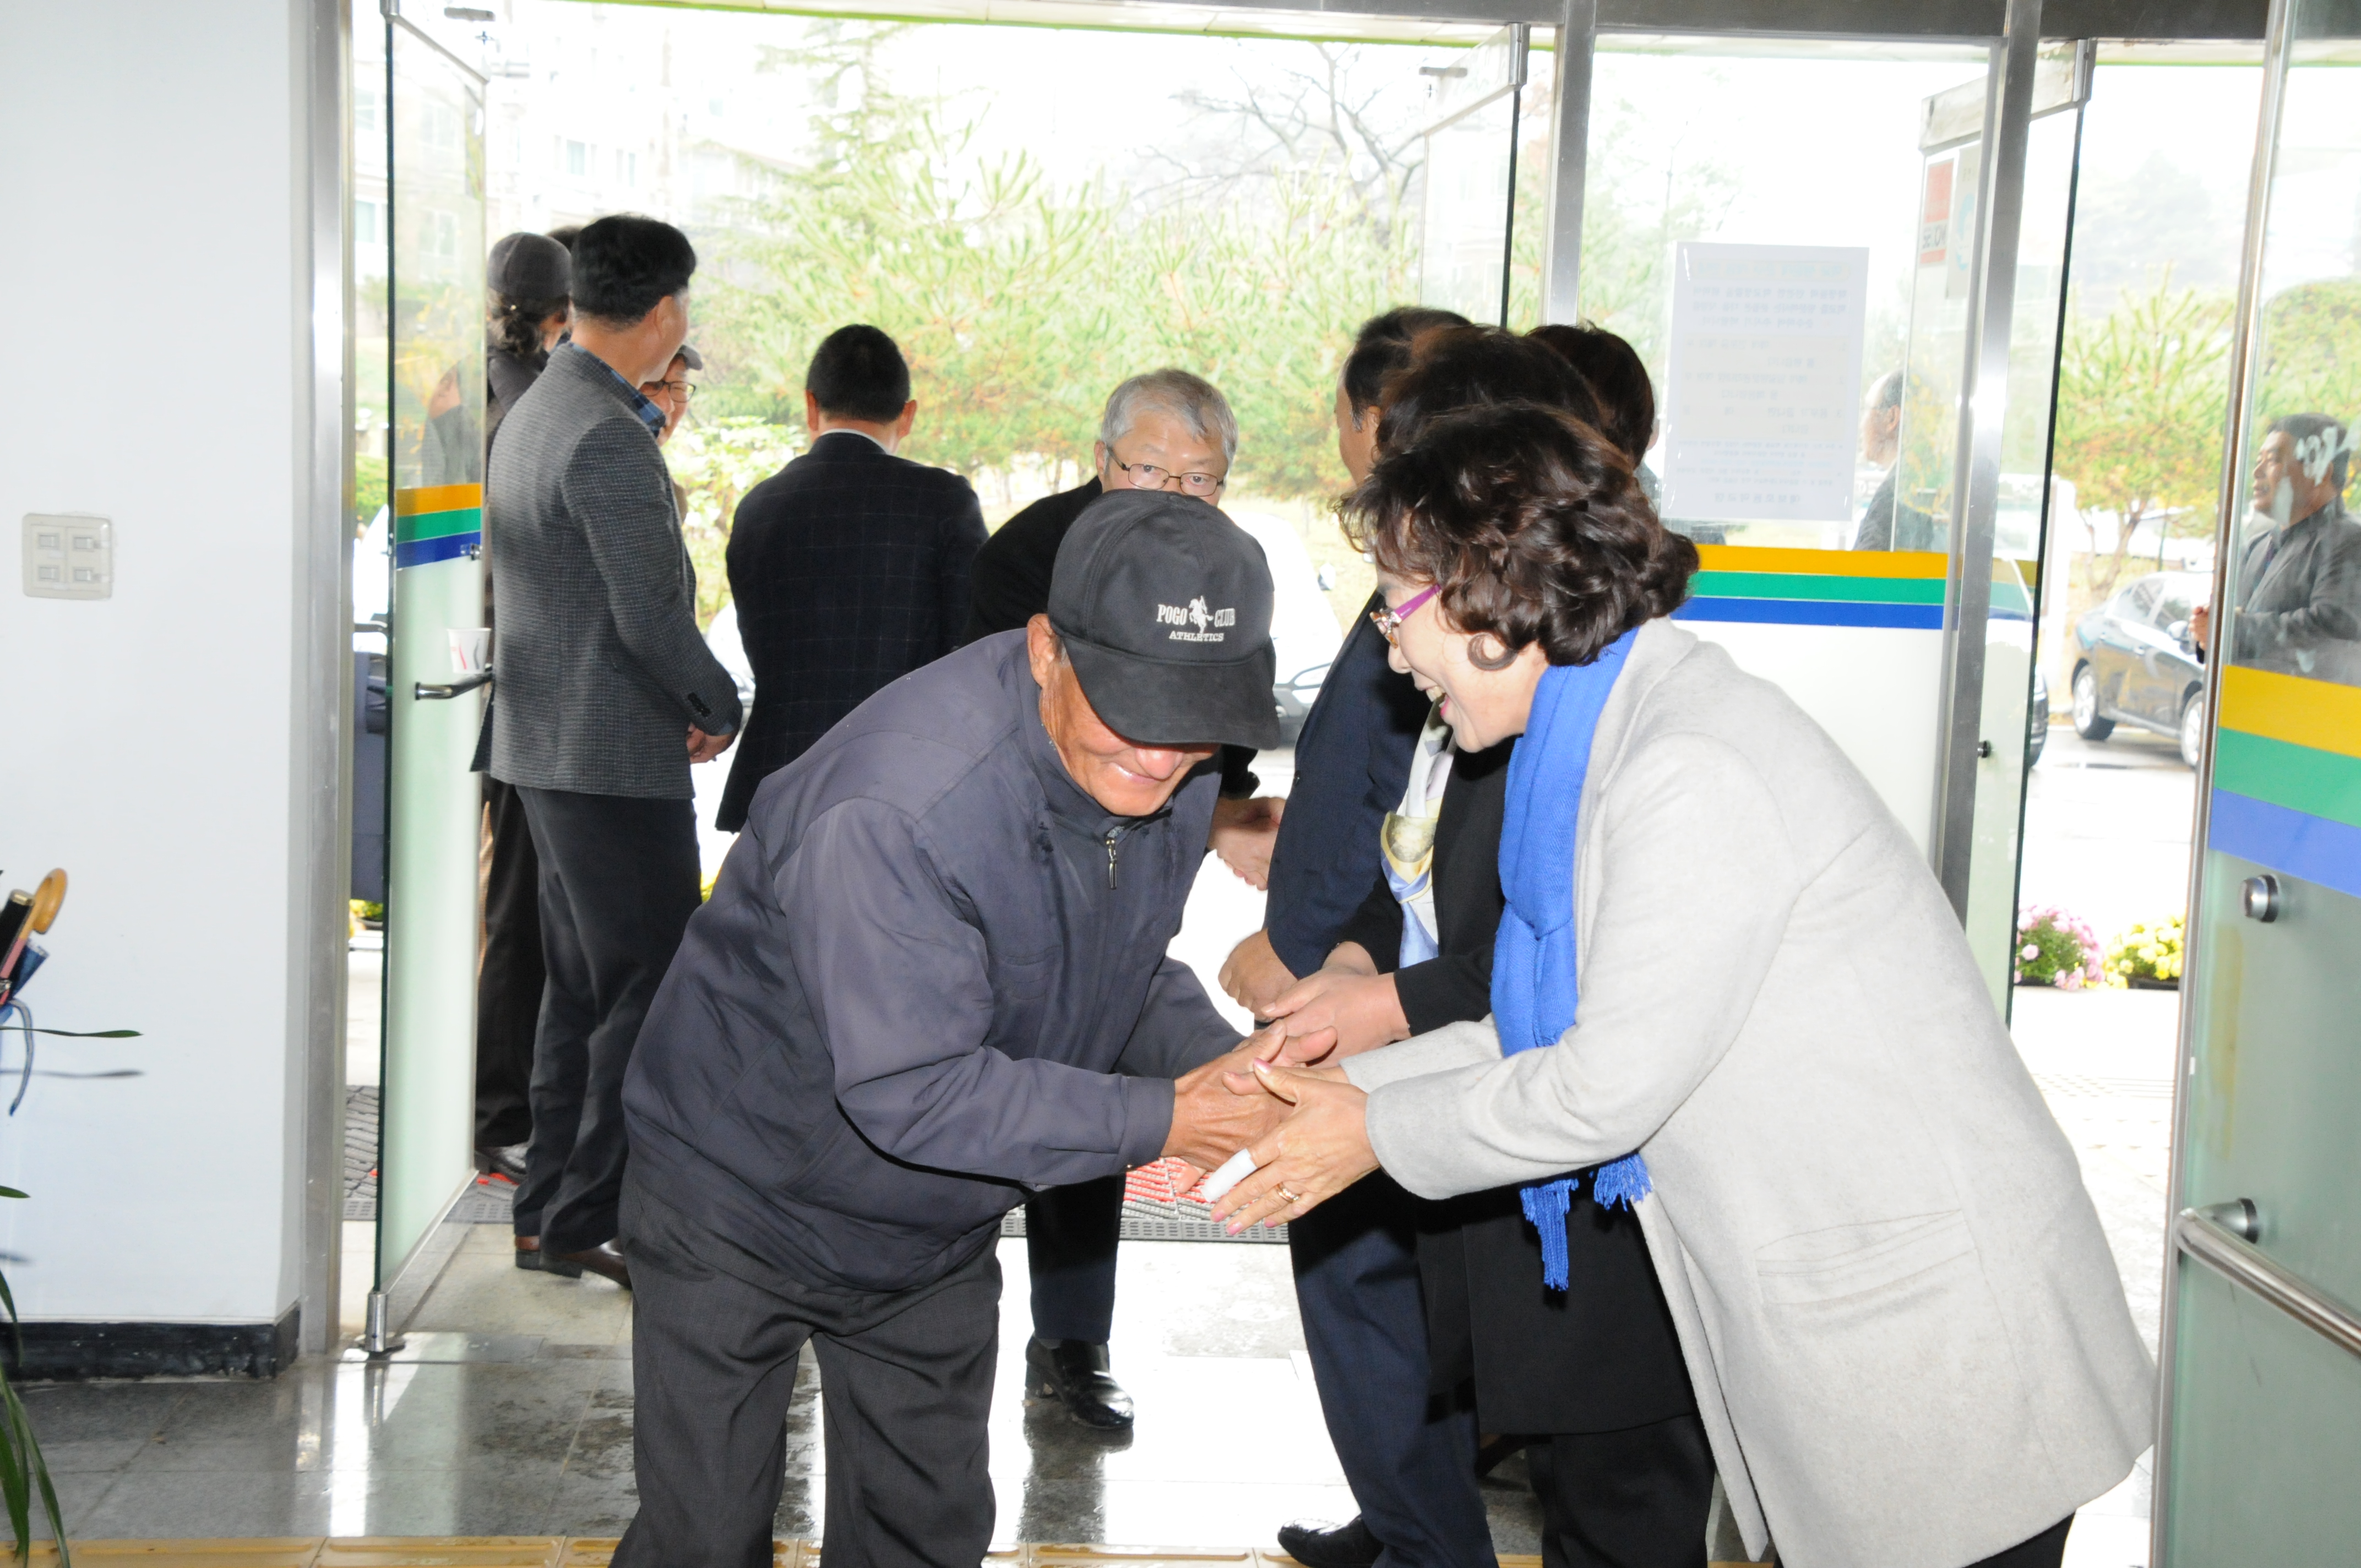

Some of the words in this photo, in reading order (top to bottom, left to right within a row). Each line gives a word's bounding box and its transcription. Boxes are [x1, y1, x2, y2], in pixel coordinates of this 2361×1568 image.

[1156, 604, 1188, 625] POGO
[1214, 608, 1236, 628] CLUB
[1168, 630, 1225, 642] ATHLETICS
